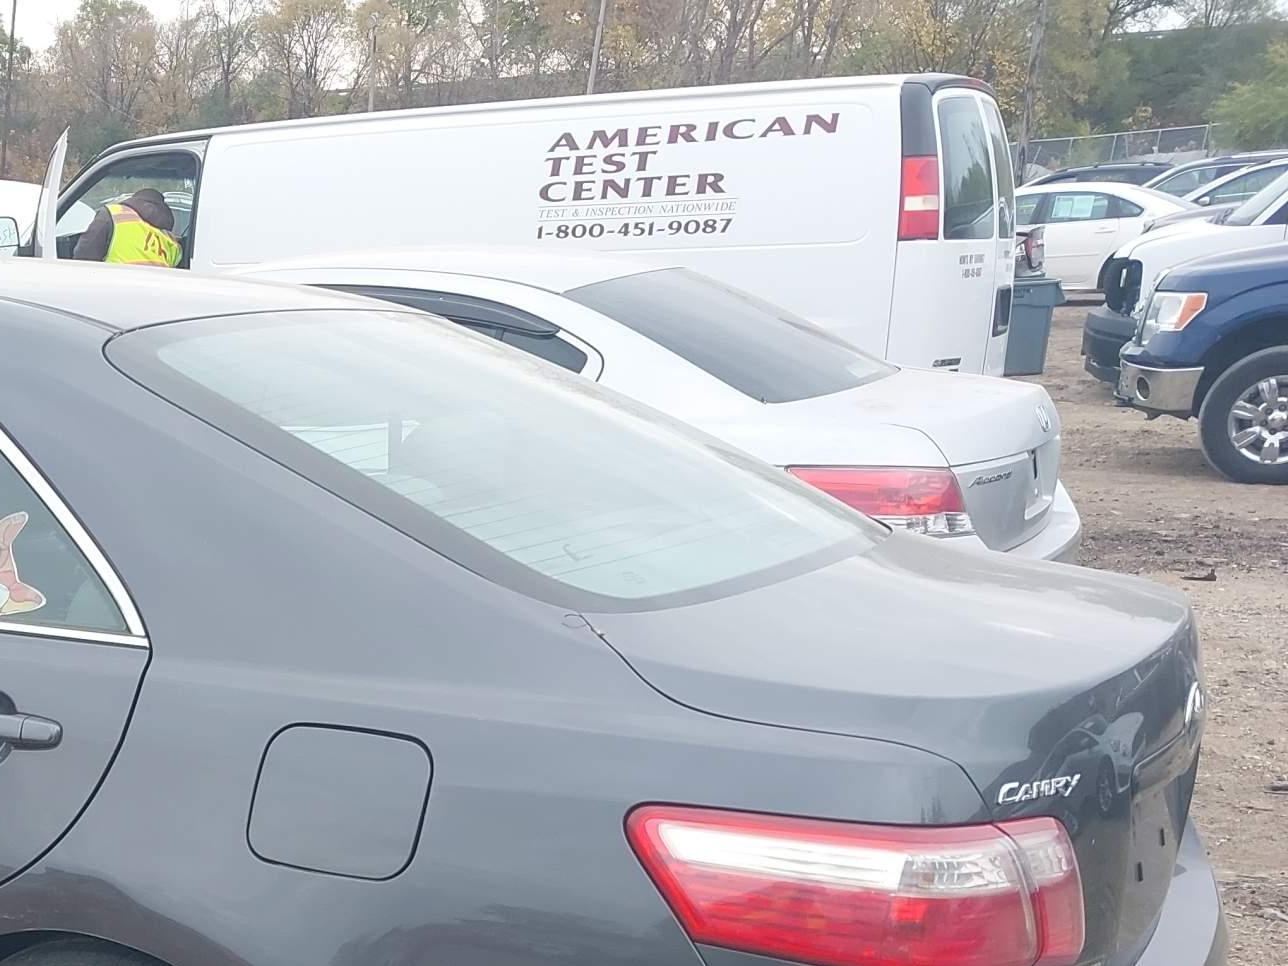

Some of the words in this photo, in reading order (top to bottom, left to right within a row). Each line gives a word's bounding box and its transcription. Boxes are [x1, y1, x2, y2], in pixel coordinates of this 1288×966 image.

[546, 112, 841, 153] AMERICAN
[544, 150, 658, 178] TEST
[538, 172, 727, 203] CENTER
[539, 208, 568, 219] TEST
[572, 207, 579, 217] &
[585, 205, 653, 217] INSPECTION
[659, 201, 736, 214] NATIONWIDE
[537, 218, 733, 240] 1-800-451-9087
[998, 774, 1081, 805] CAMRY
